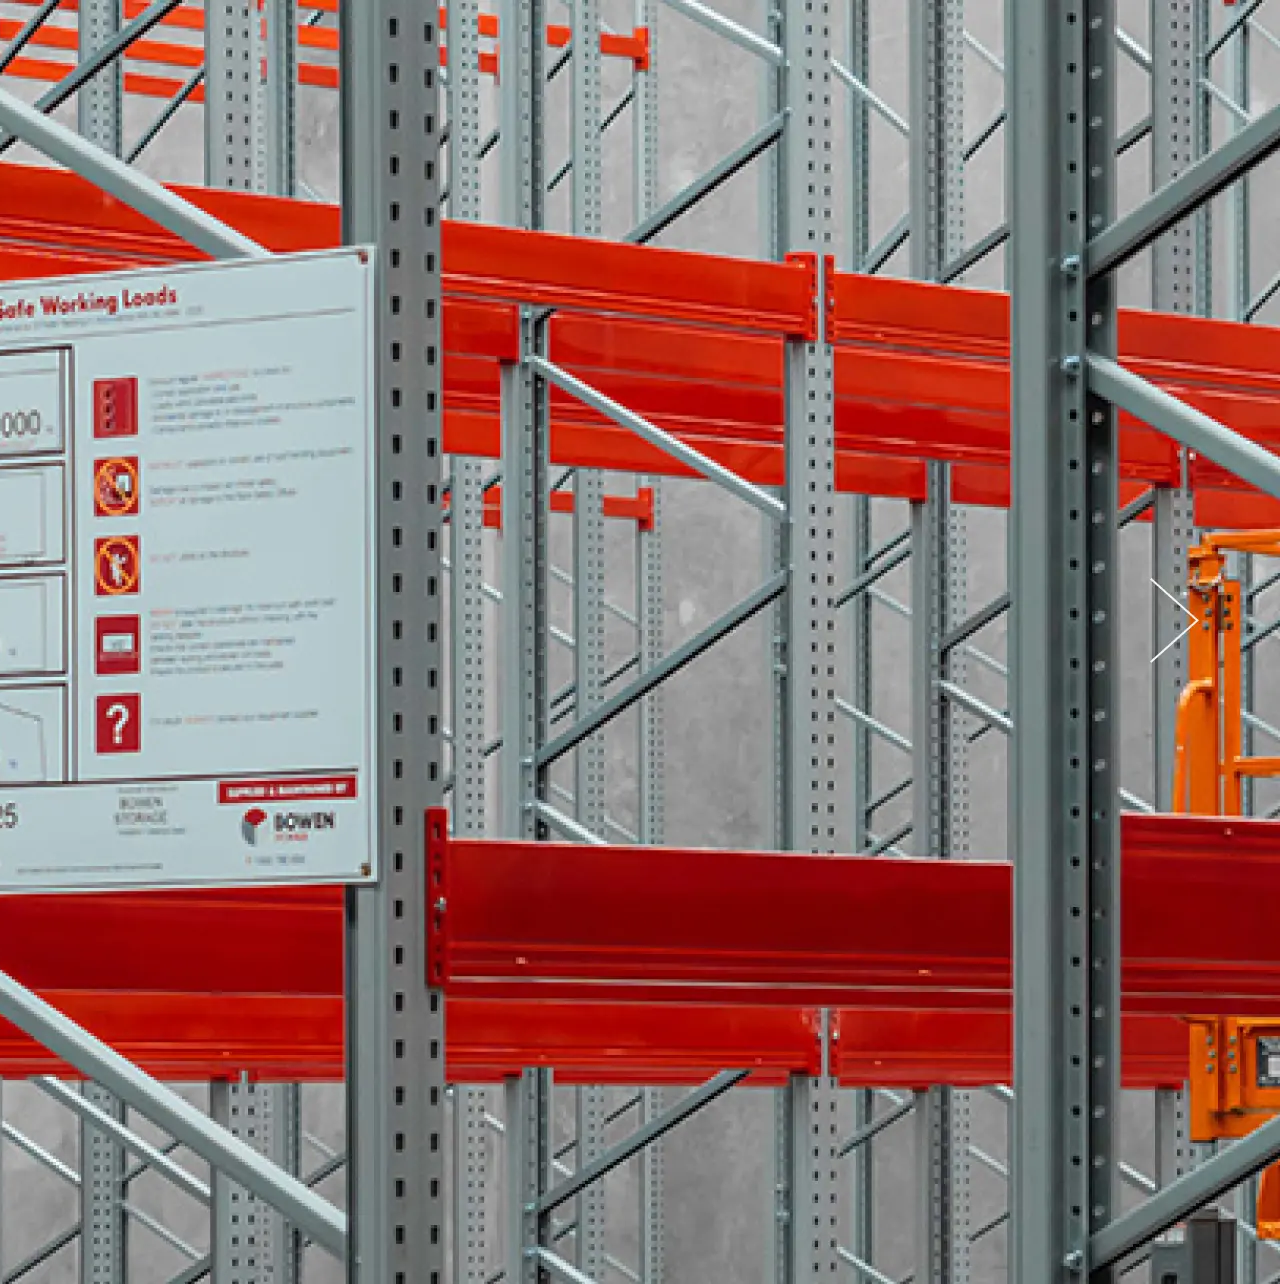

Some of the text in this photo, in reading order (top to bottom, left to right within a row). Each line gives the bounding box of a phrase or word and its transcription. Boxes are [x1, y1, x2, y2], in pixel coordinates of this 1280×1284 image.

[40, 292, 118, 316] Working
[122, 283, 177, 309] Loads
[274, 811, 336, 831] BOWEN
